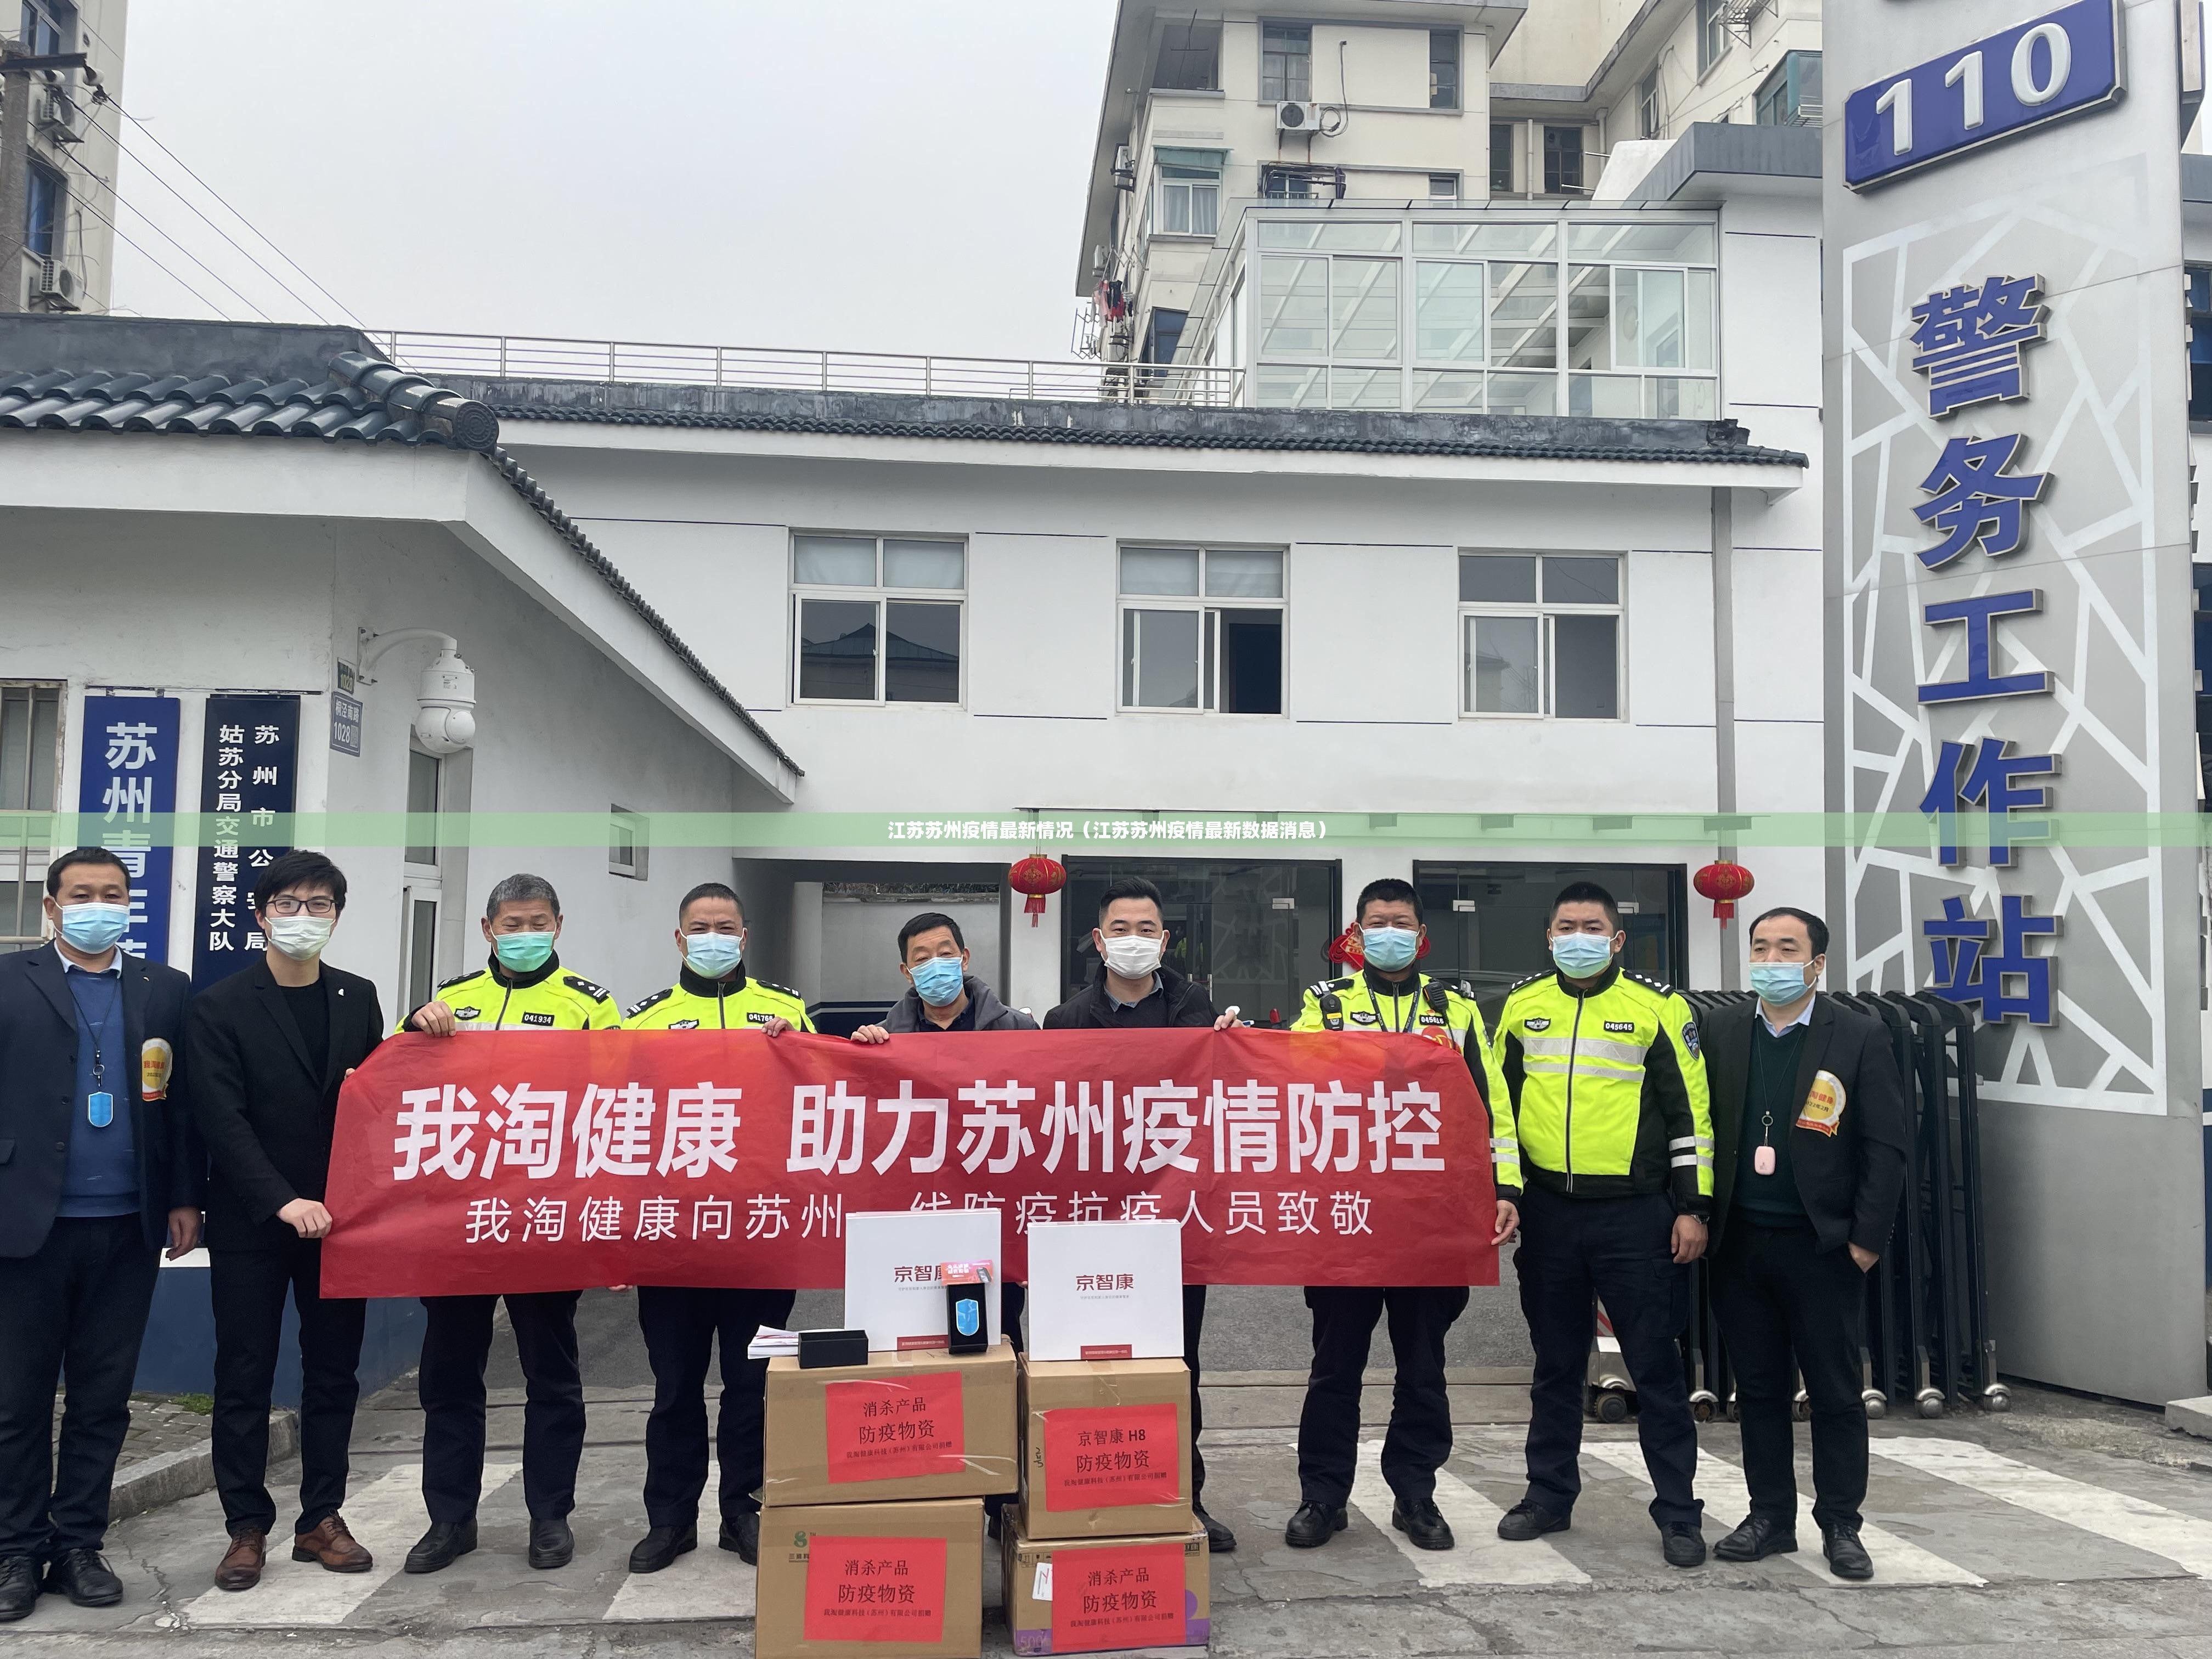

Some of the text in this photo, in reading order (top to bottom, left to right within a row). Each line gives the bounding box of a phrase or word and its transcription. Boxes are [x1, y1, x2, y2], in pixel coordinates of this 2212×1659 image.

[1876, 22, 2072, 156] 110
[1909, 273, 2061, 1027] 警务工作站
[341, 673, 353, 692] 1028
[335, 699, 359, 723] 桐泾南路
[334, 722, 350, 743] 1028
[209, 724, 245, 951] 姑苏分局交通警察大队
[524, 1014, 552, 1024] 041934
[1605, 1023, 1633, 1031] 045645
[393, 1079, 1446, 1181] 我淘健康 助力苏州疫情防控
[1076, 1273, 1134, 1291] 京智康
[863, 1397, 926, 1418] 消杀产品
[860, 1419, 935, 1444] 防疫物资
[1078, 1428, 1146, 1447] 京智康 H8
[1076, 1449, 1150, 1474] 防疫物资
[845, 1559, 909, 1576] 消杀产品
[1087, 1567, 1149, 1587] 消杀产品
[838, 1583, 916, 1604] 防疫物资
[1083, 1589, 1158, 1614] 防疫物资
